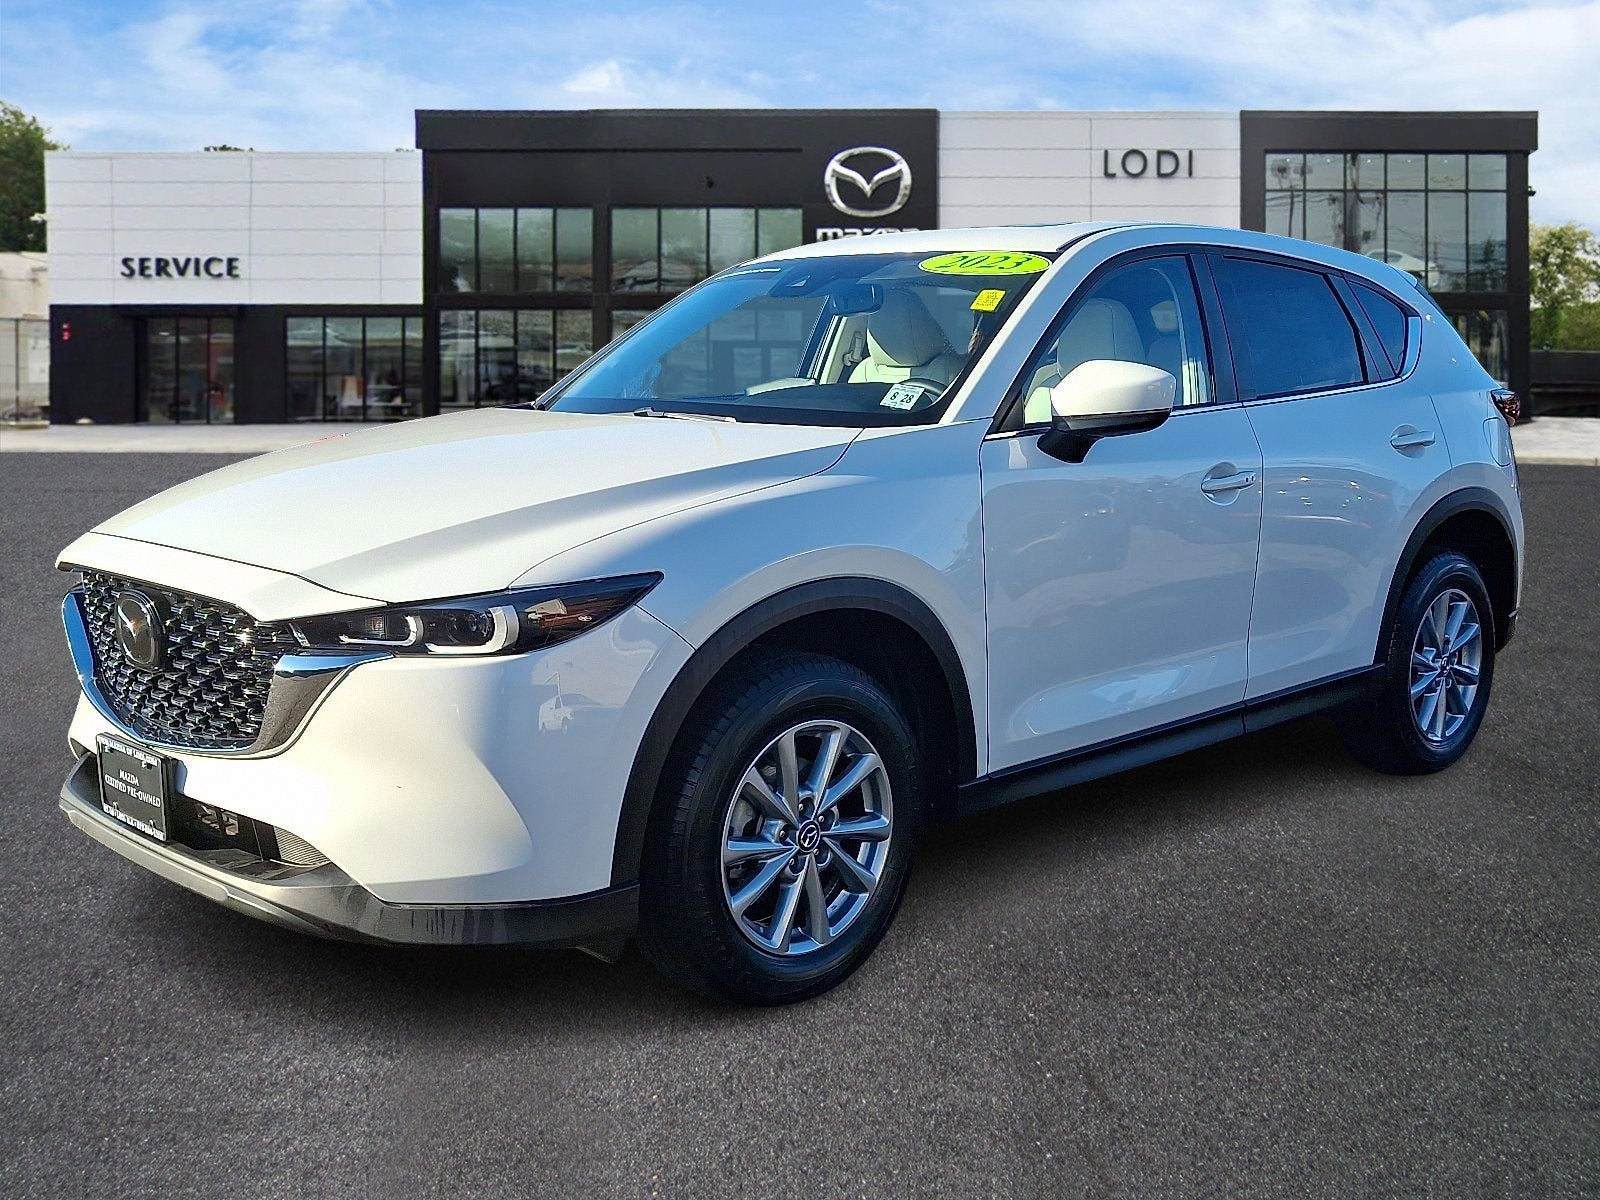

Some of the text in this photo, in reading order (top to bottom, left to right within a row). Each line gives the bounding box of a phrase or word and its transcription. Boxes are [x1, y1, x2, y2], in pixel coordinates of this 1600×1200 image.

[1103, 149, 1193, 178] LODI
[120, 257, 240, 278] SERVICE
[934, 255, 1032, 270] 2023
[890, 391, 915, 403] 8 28
[119, 769, 139, 786] MAZDA
[127, 785, 160, 807] PRE-OWNED
